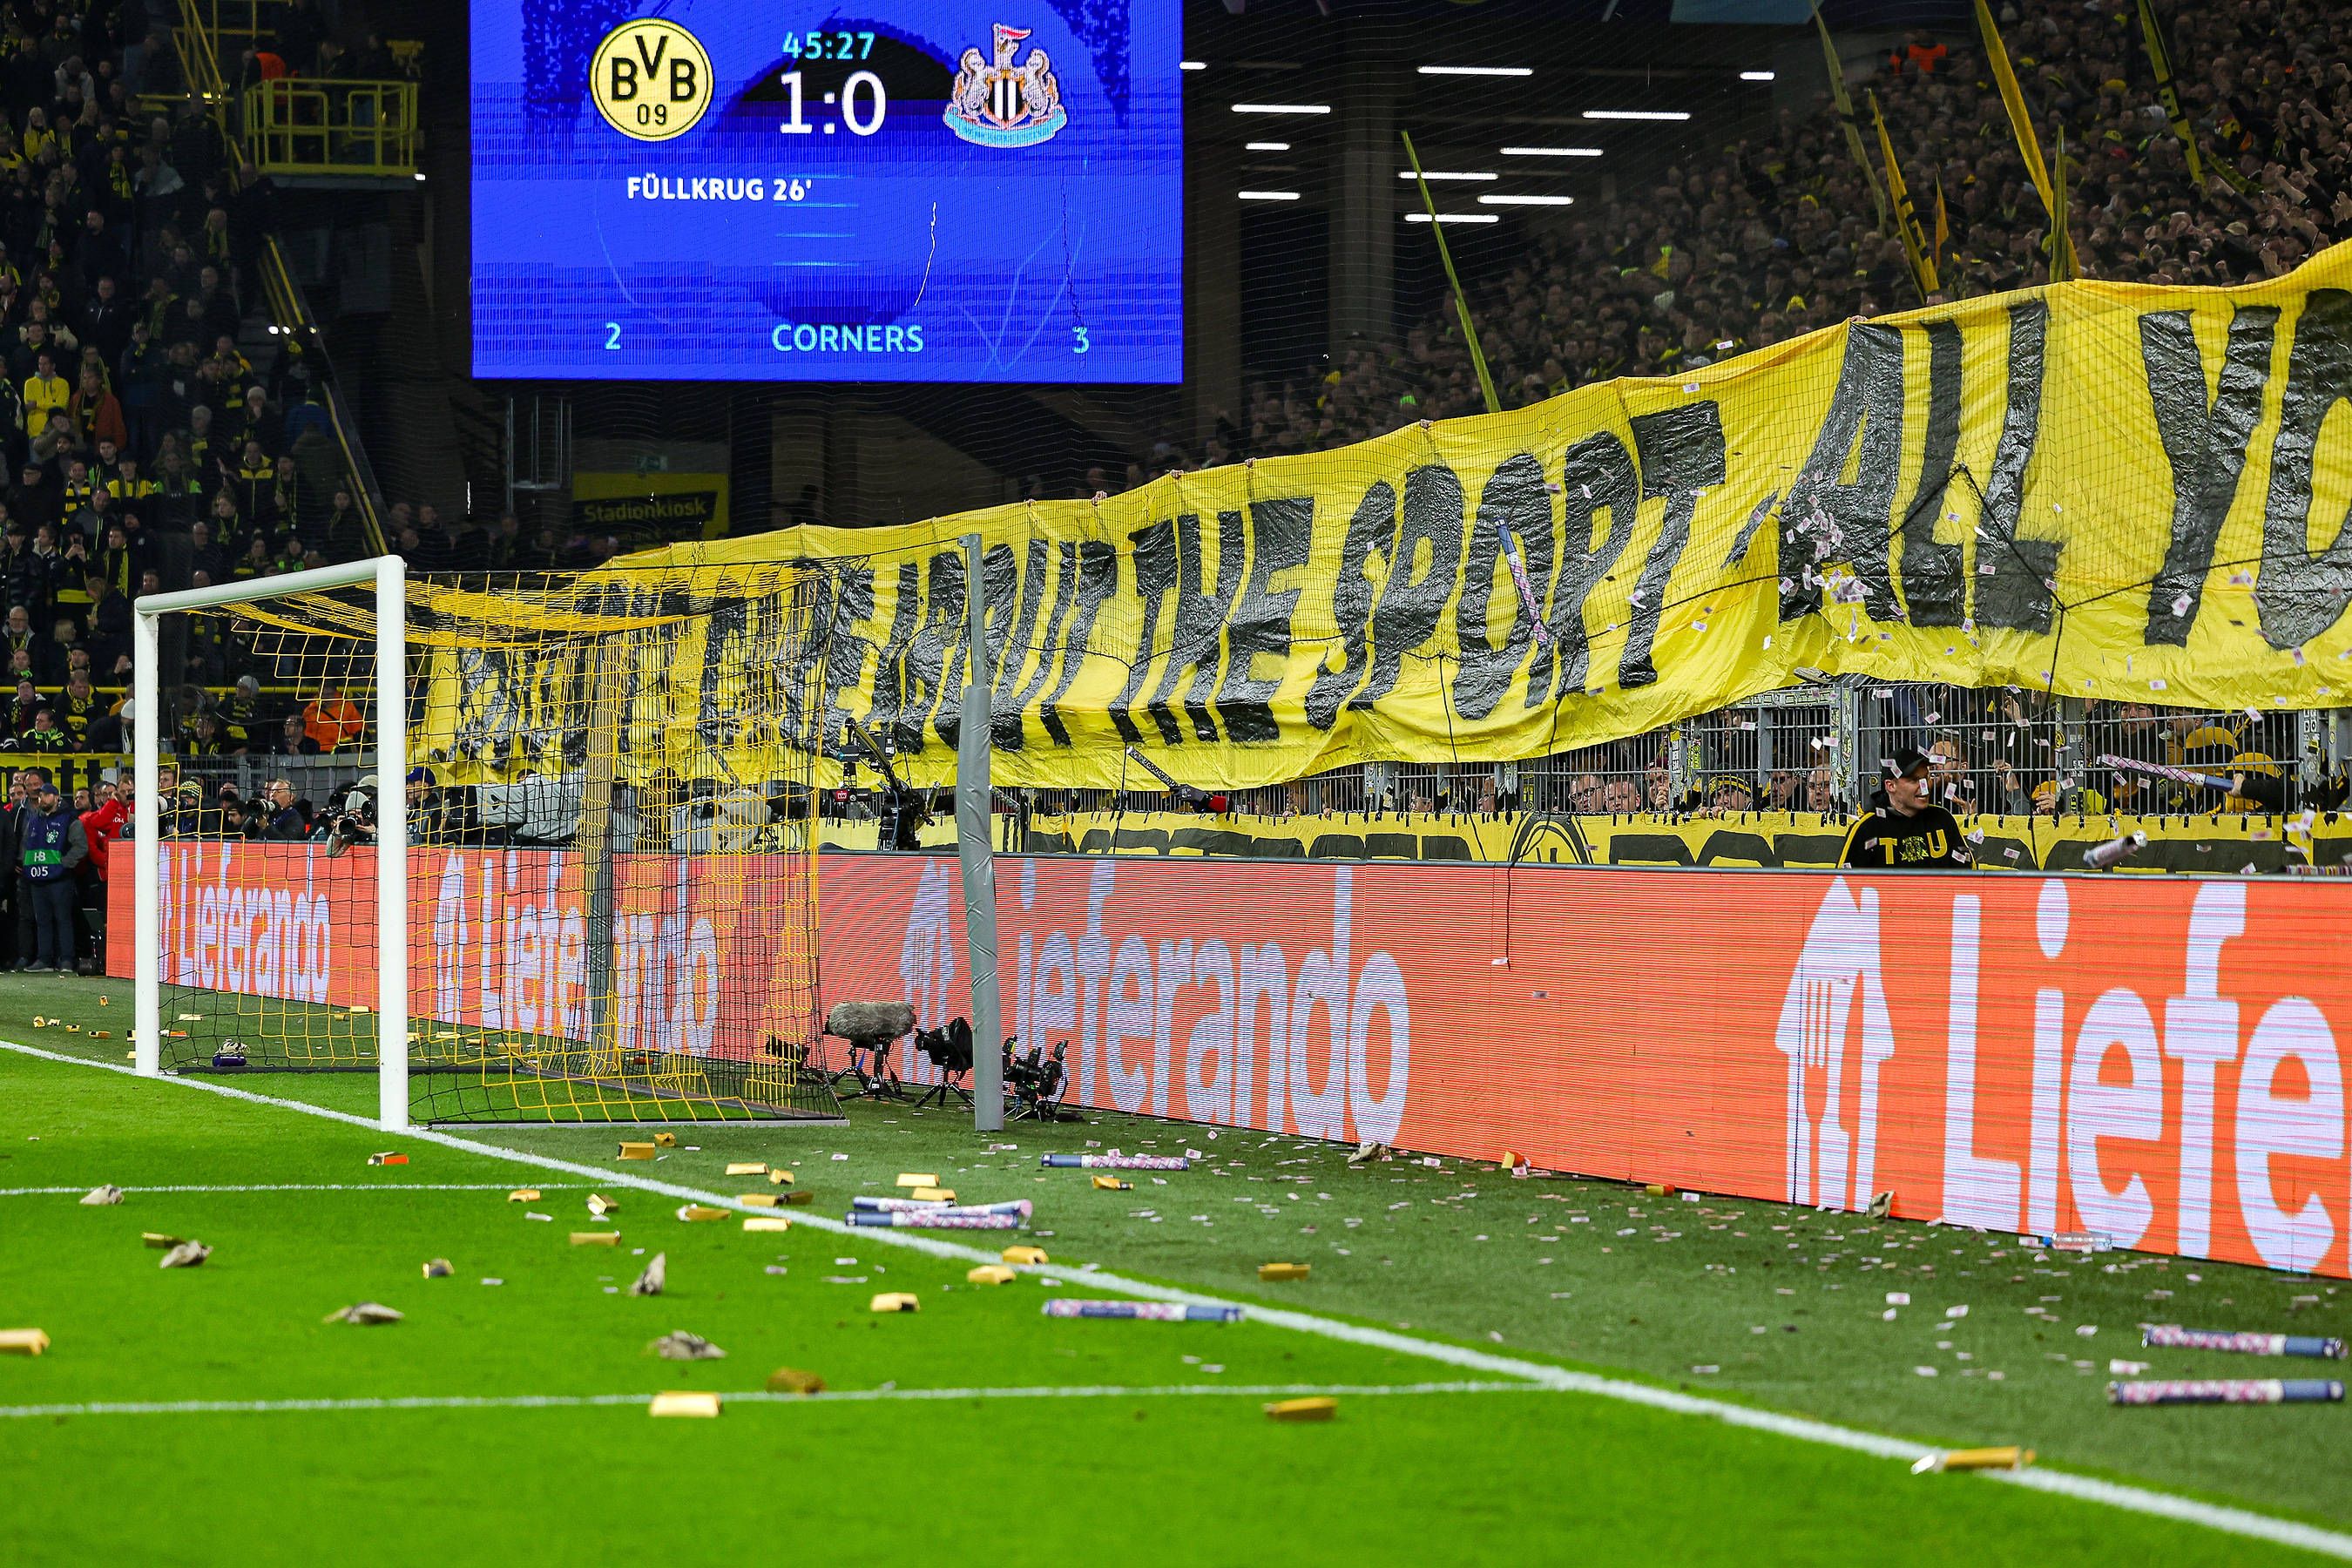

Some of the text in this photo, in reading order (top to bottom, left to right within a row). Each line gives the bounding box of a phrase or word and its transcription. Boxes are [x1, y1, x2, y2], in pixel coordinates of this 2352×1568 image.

[612, 35, 696, 102] BVB
[781, 31, 875, 59] 45:27
[638, 104, 666, 125] 09
[781, 70, 886, 136] 1:0
[627, 172, 812, 201] FÜLLKRUG 26'
[605, 322, 621, 350] 2
[771, 324, 924, 354] CORNERS
[1072, 325, 1090, 354] 3
[584, 497, 706, 523] Stadionkiosk
[1109, 497, 1314, 745] THE
[1306, 402, 1726, 732] SPORT
[1779, 297, 2063, 635] ALL
[179, 841, 331, 1004] Lieferando
[482, 850, 719, 1056] Liefendo
[1017, 859, 1409, 1147] ieferando
[1942, 878, 2352, 1274] Liefe
